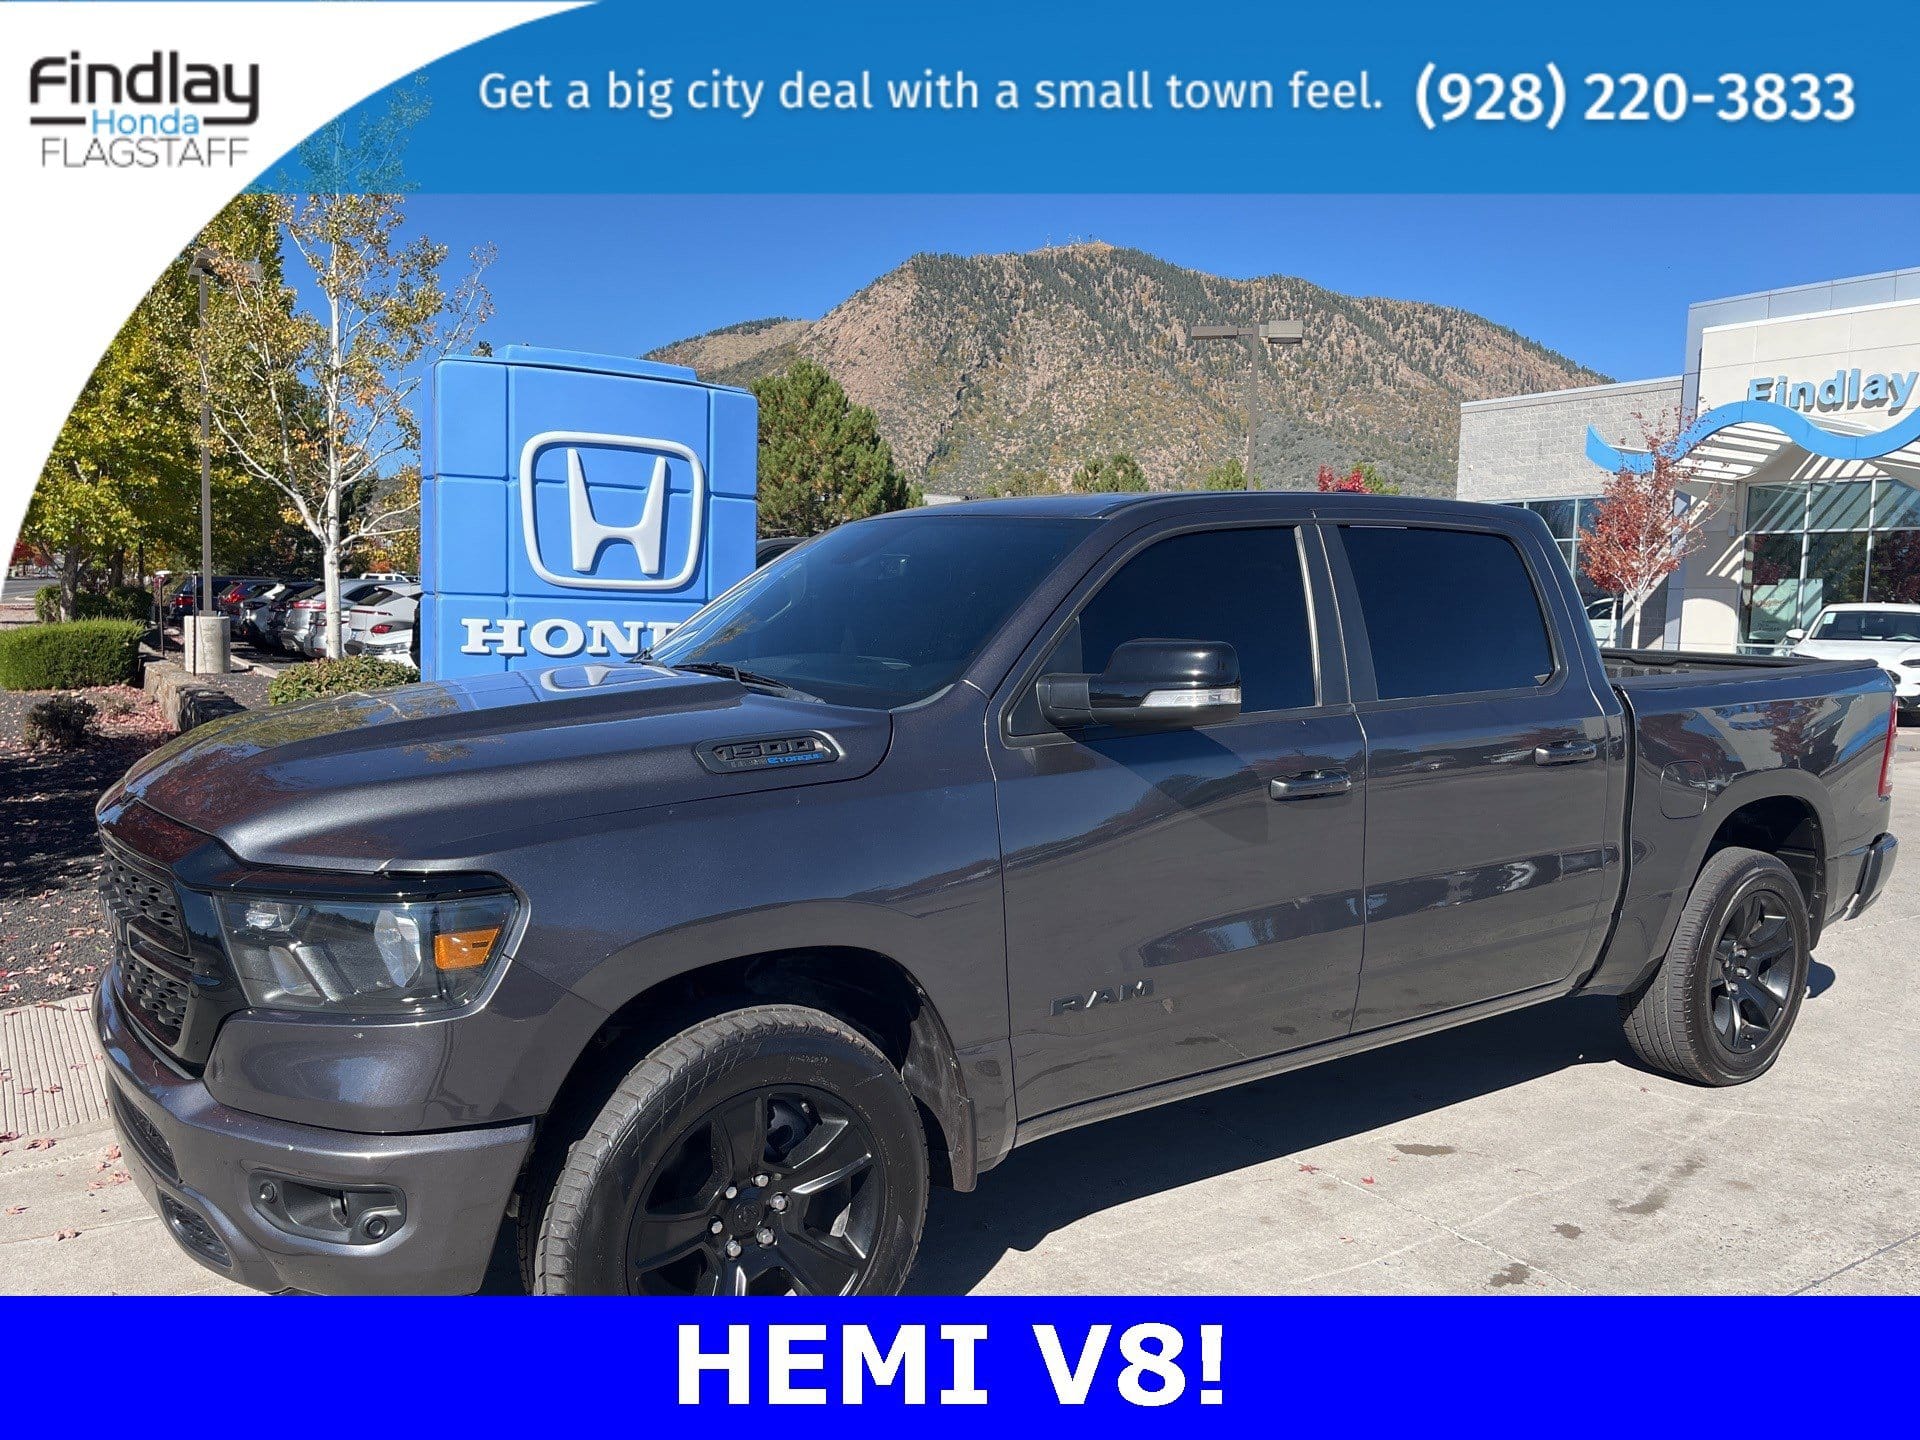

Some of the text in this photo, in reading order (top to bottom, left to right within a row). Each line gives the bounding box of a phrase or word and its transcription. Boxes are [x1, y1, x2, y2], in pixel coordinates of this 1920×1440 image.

[1747, 368, 1919, 416] Findlay
[460, 618, 684, 658] HON
[712, 737, 818, 761] 1500
[1050, 978, 1154, 1016] RAM
